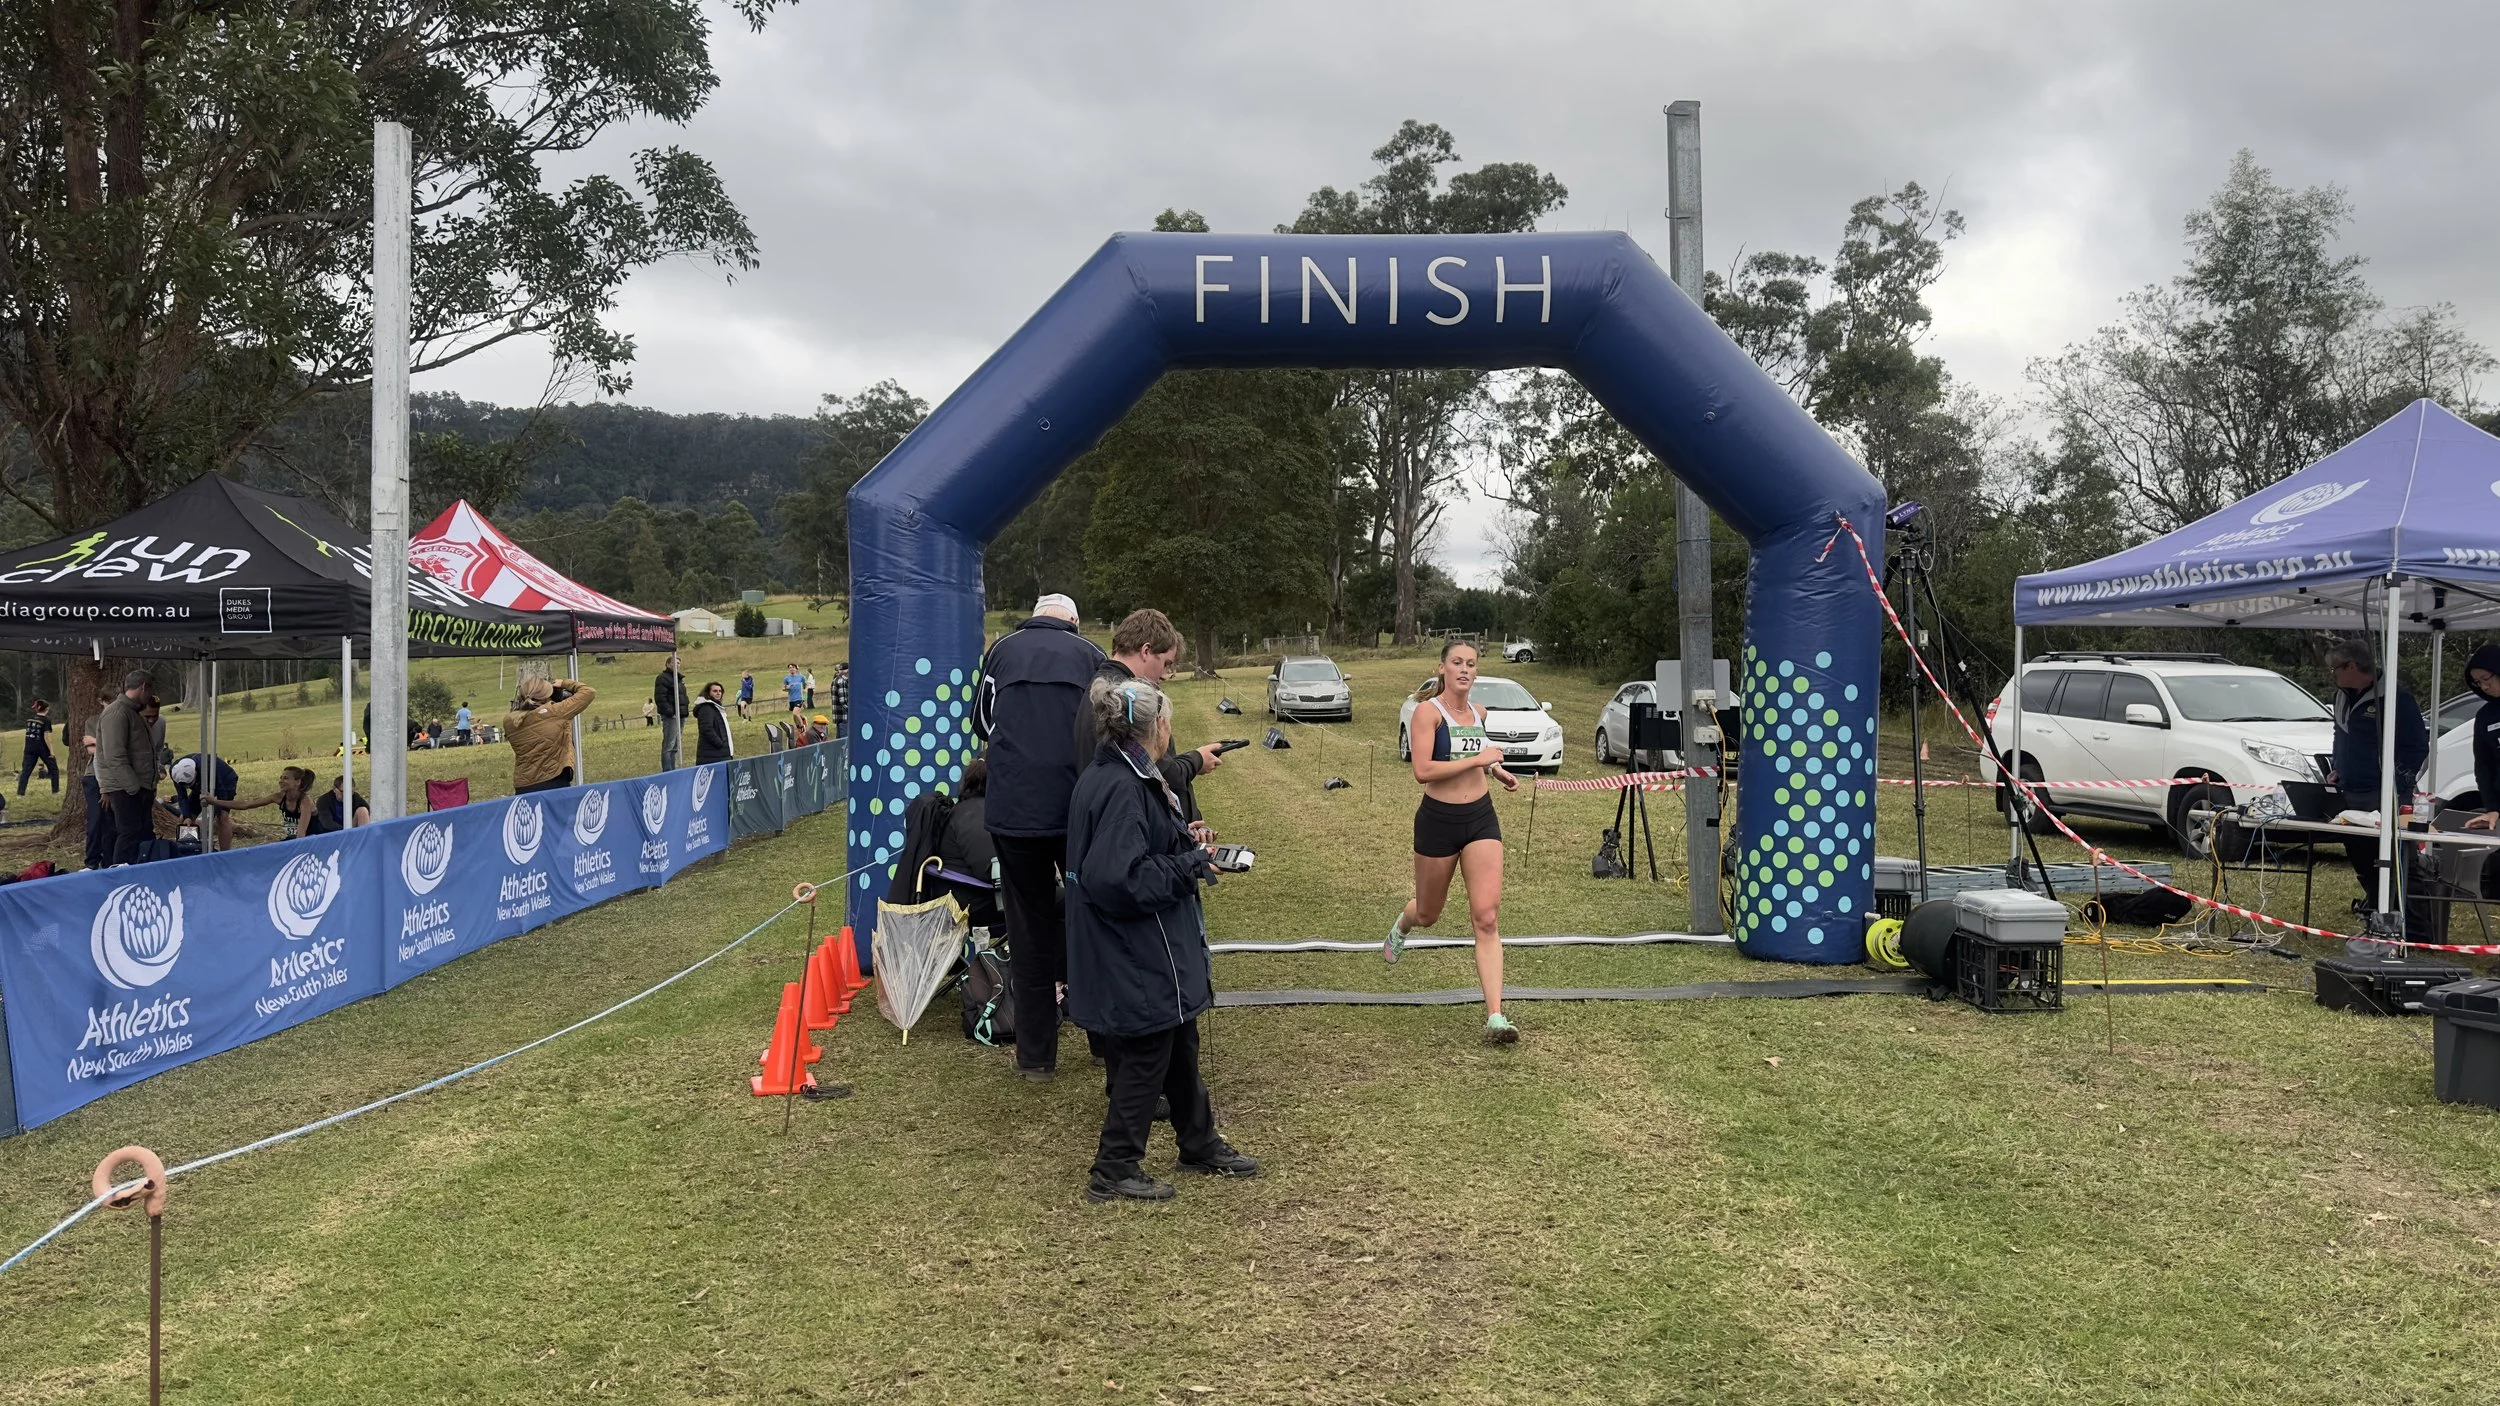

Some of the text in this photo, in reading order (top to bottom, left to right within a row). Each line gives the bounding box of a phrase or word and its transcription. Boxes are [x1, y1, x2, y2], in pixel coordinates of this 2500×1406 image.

[1195, 255, 1552, 326] FINISH
[92, 536, 251, 569] run
[424, 545, 473, 558] GEORGE
[0, 556, 238, 584] crew
[2037, 550, 2354, 607] www.nswathletics.org.au
[577, 620, 604, 639] Home
[604, 622, 613, 639] of
[613, 622, 626, 640] the
[627, 622, 640, 640] Red
[641, 624, 654, 641] and
[1461, 737, 1481, 751] 229
[686, 816, 707, 839] Athletics
[574, 848, 611, 878] Athletics
[500, 868, 548, 903] Athletics
[574, 869, 616, 894] New South Wales
[401, 899, 450, 940] Athletics
[496, 893, 551, 922] New South Wales
[398, 927, 456, 963] New South Wales
[76, 993, 191, 1051] Athletics
[255, 996, 291, 1018] New
[67, 1032, 192, 1083] New South Wales
